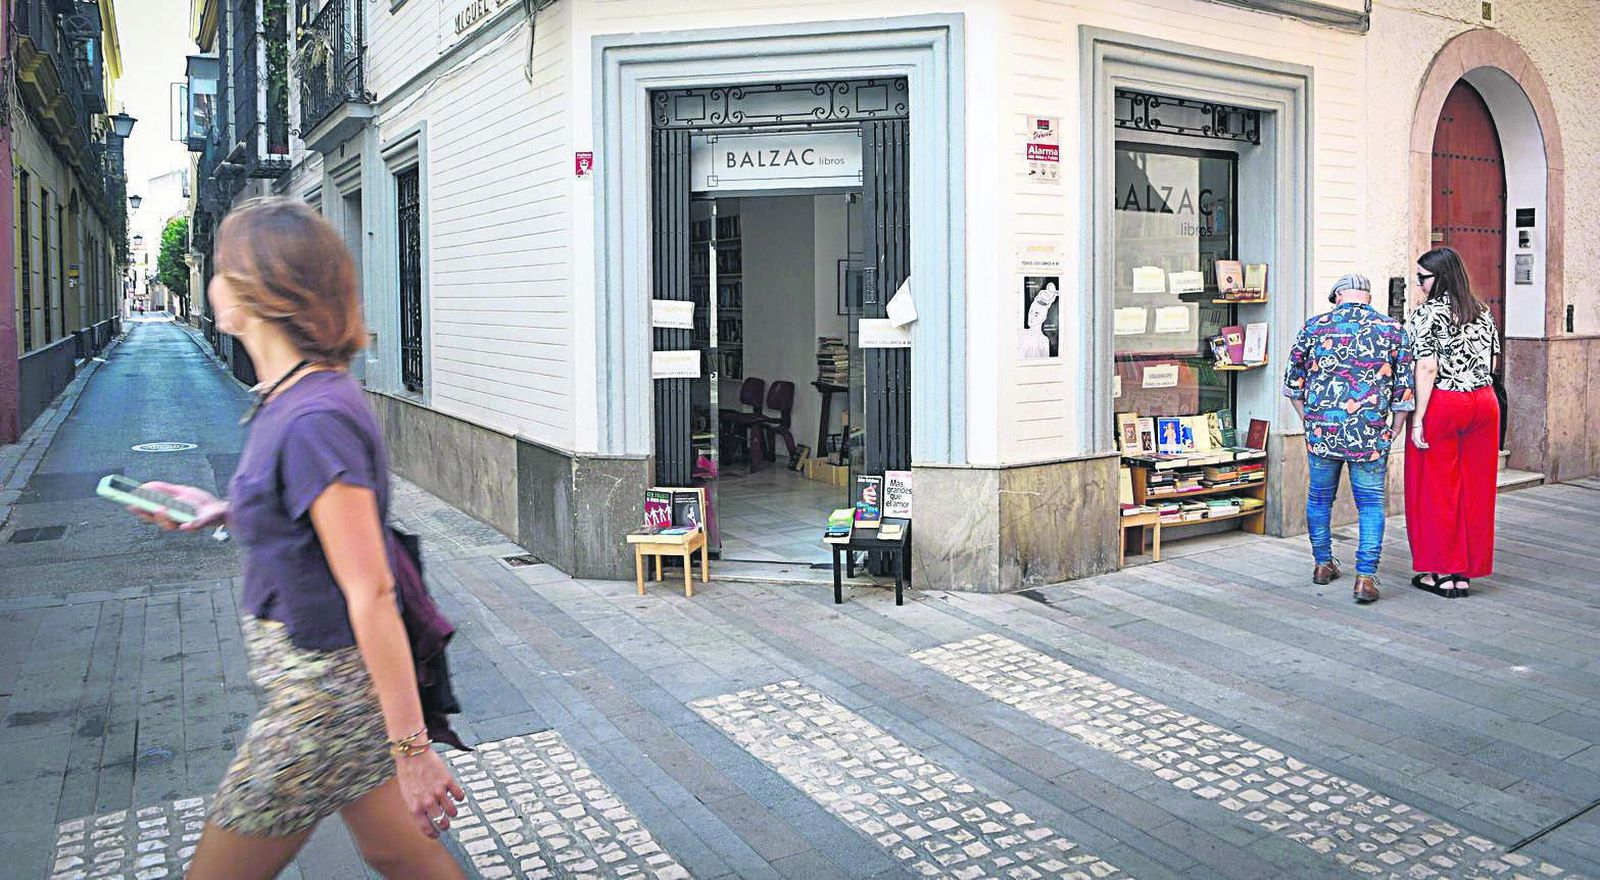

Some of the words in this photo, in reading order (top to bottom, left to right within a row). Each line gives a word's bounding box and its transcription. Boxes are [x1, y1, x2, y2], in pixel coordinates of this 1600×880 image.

[454, 0, 490, 35] MIGUEL
[726, 148, 815, 169] BALZAC
[818, 156, 846, 166] libros
[1028, 145, 1059, 156] Alarma
[1180, 222, 1213, 237] libros
